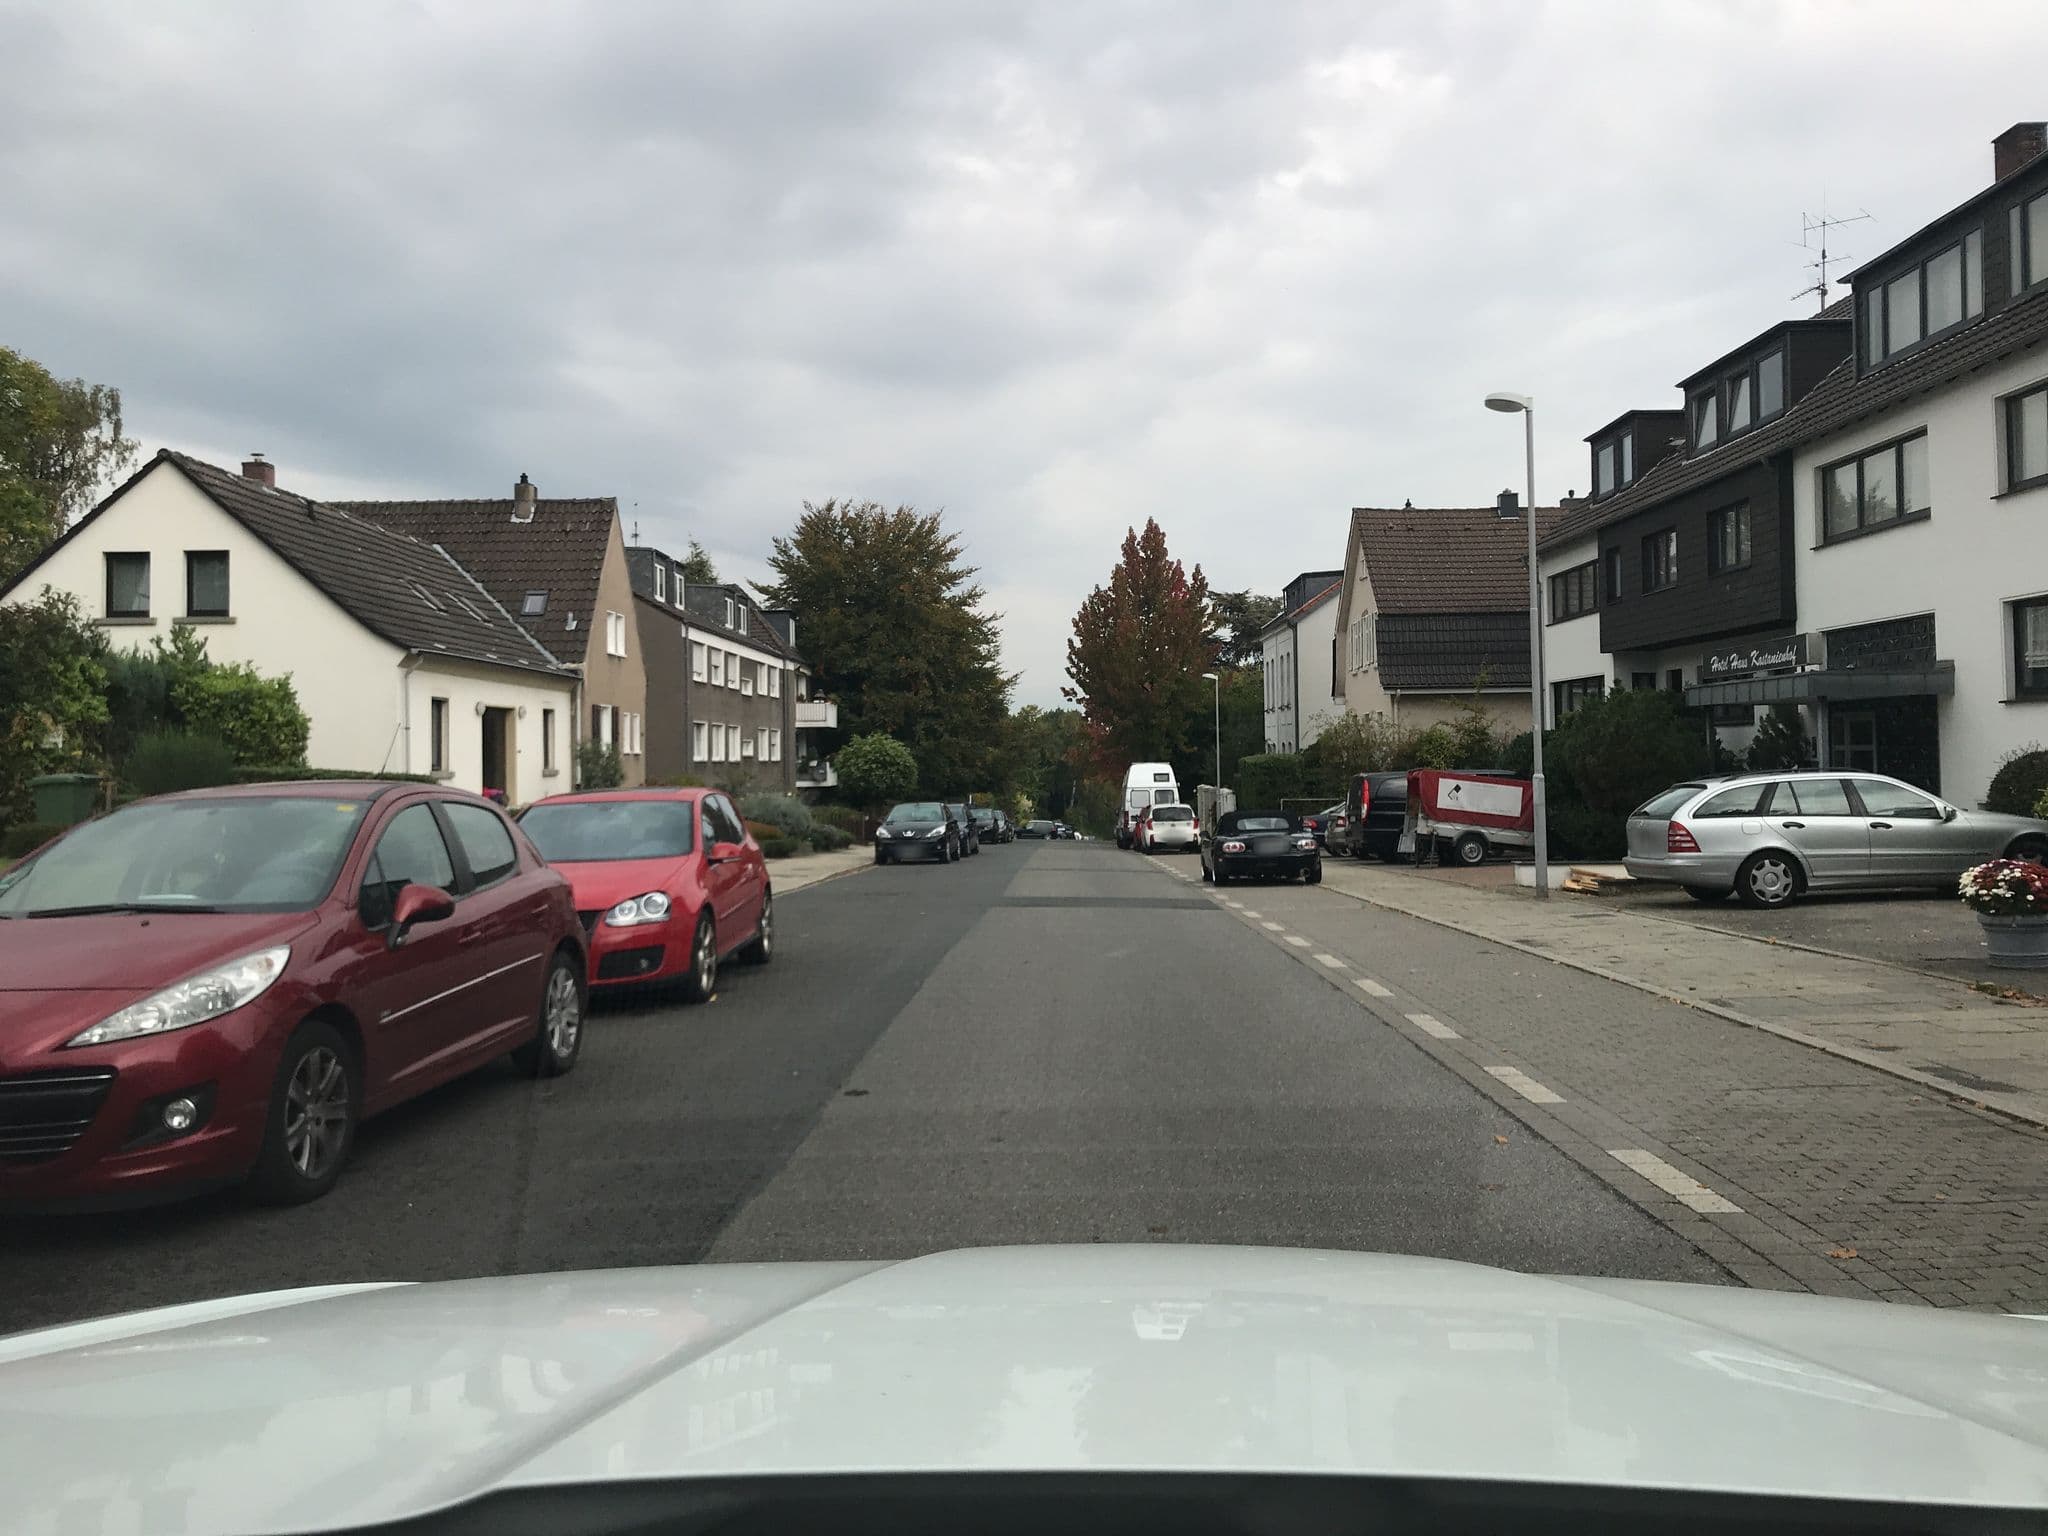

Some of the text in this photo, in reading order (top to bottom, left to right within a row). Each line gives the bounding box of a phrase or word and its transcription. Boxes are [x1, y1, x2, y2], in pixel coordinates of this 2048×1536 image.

[1710, 645, 1797, 672] Hotel Haus Kastanienhof
